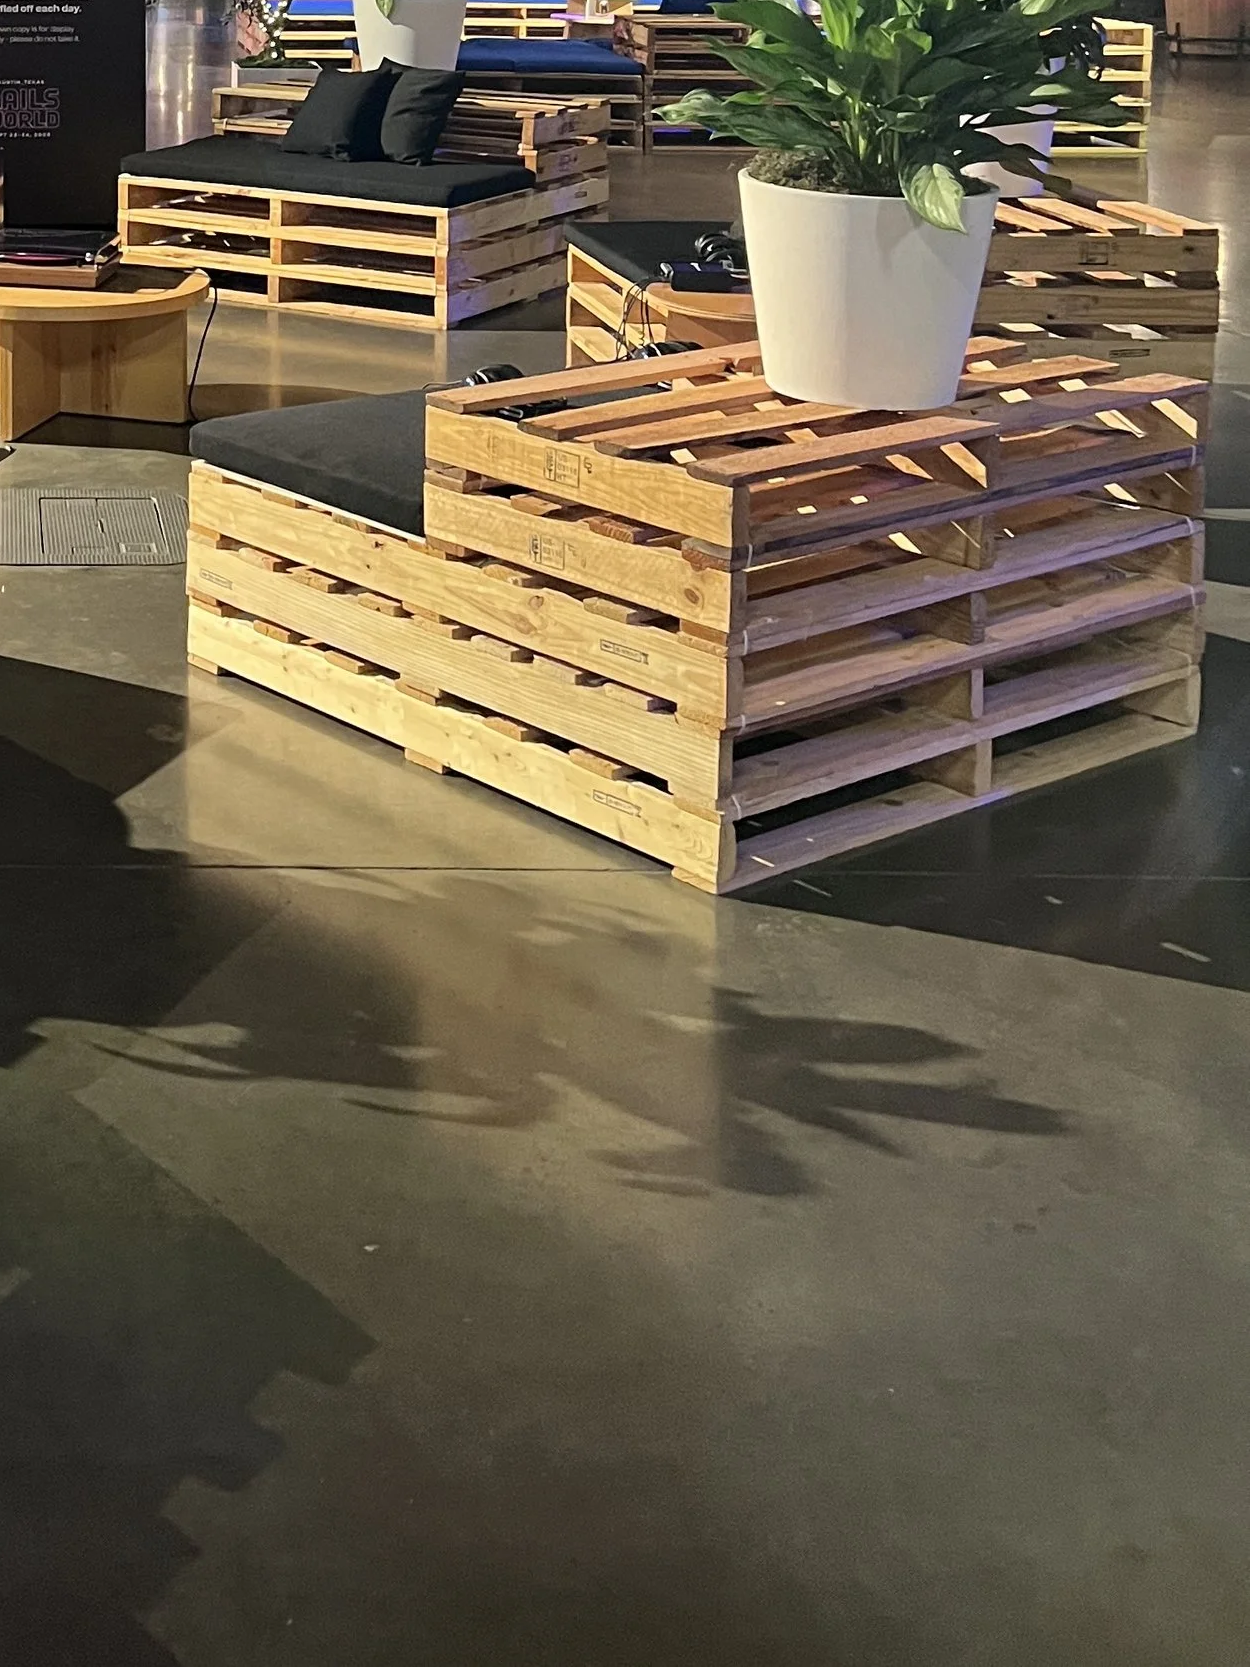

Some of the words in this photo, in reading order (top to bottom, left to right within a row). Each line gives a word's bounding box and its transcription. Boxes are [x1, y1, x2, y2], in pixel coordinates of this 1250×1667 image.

[20, 4, 34, 13] off
[35, 4, 60, 13] each
[61, 4, 82, 14] day.
